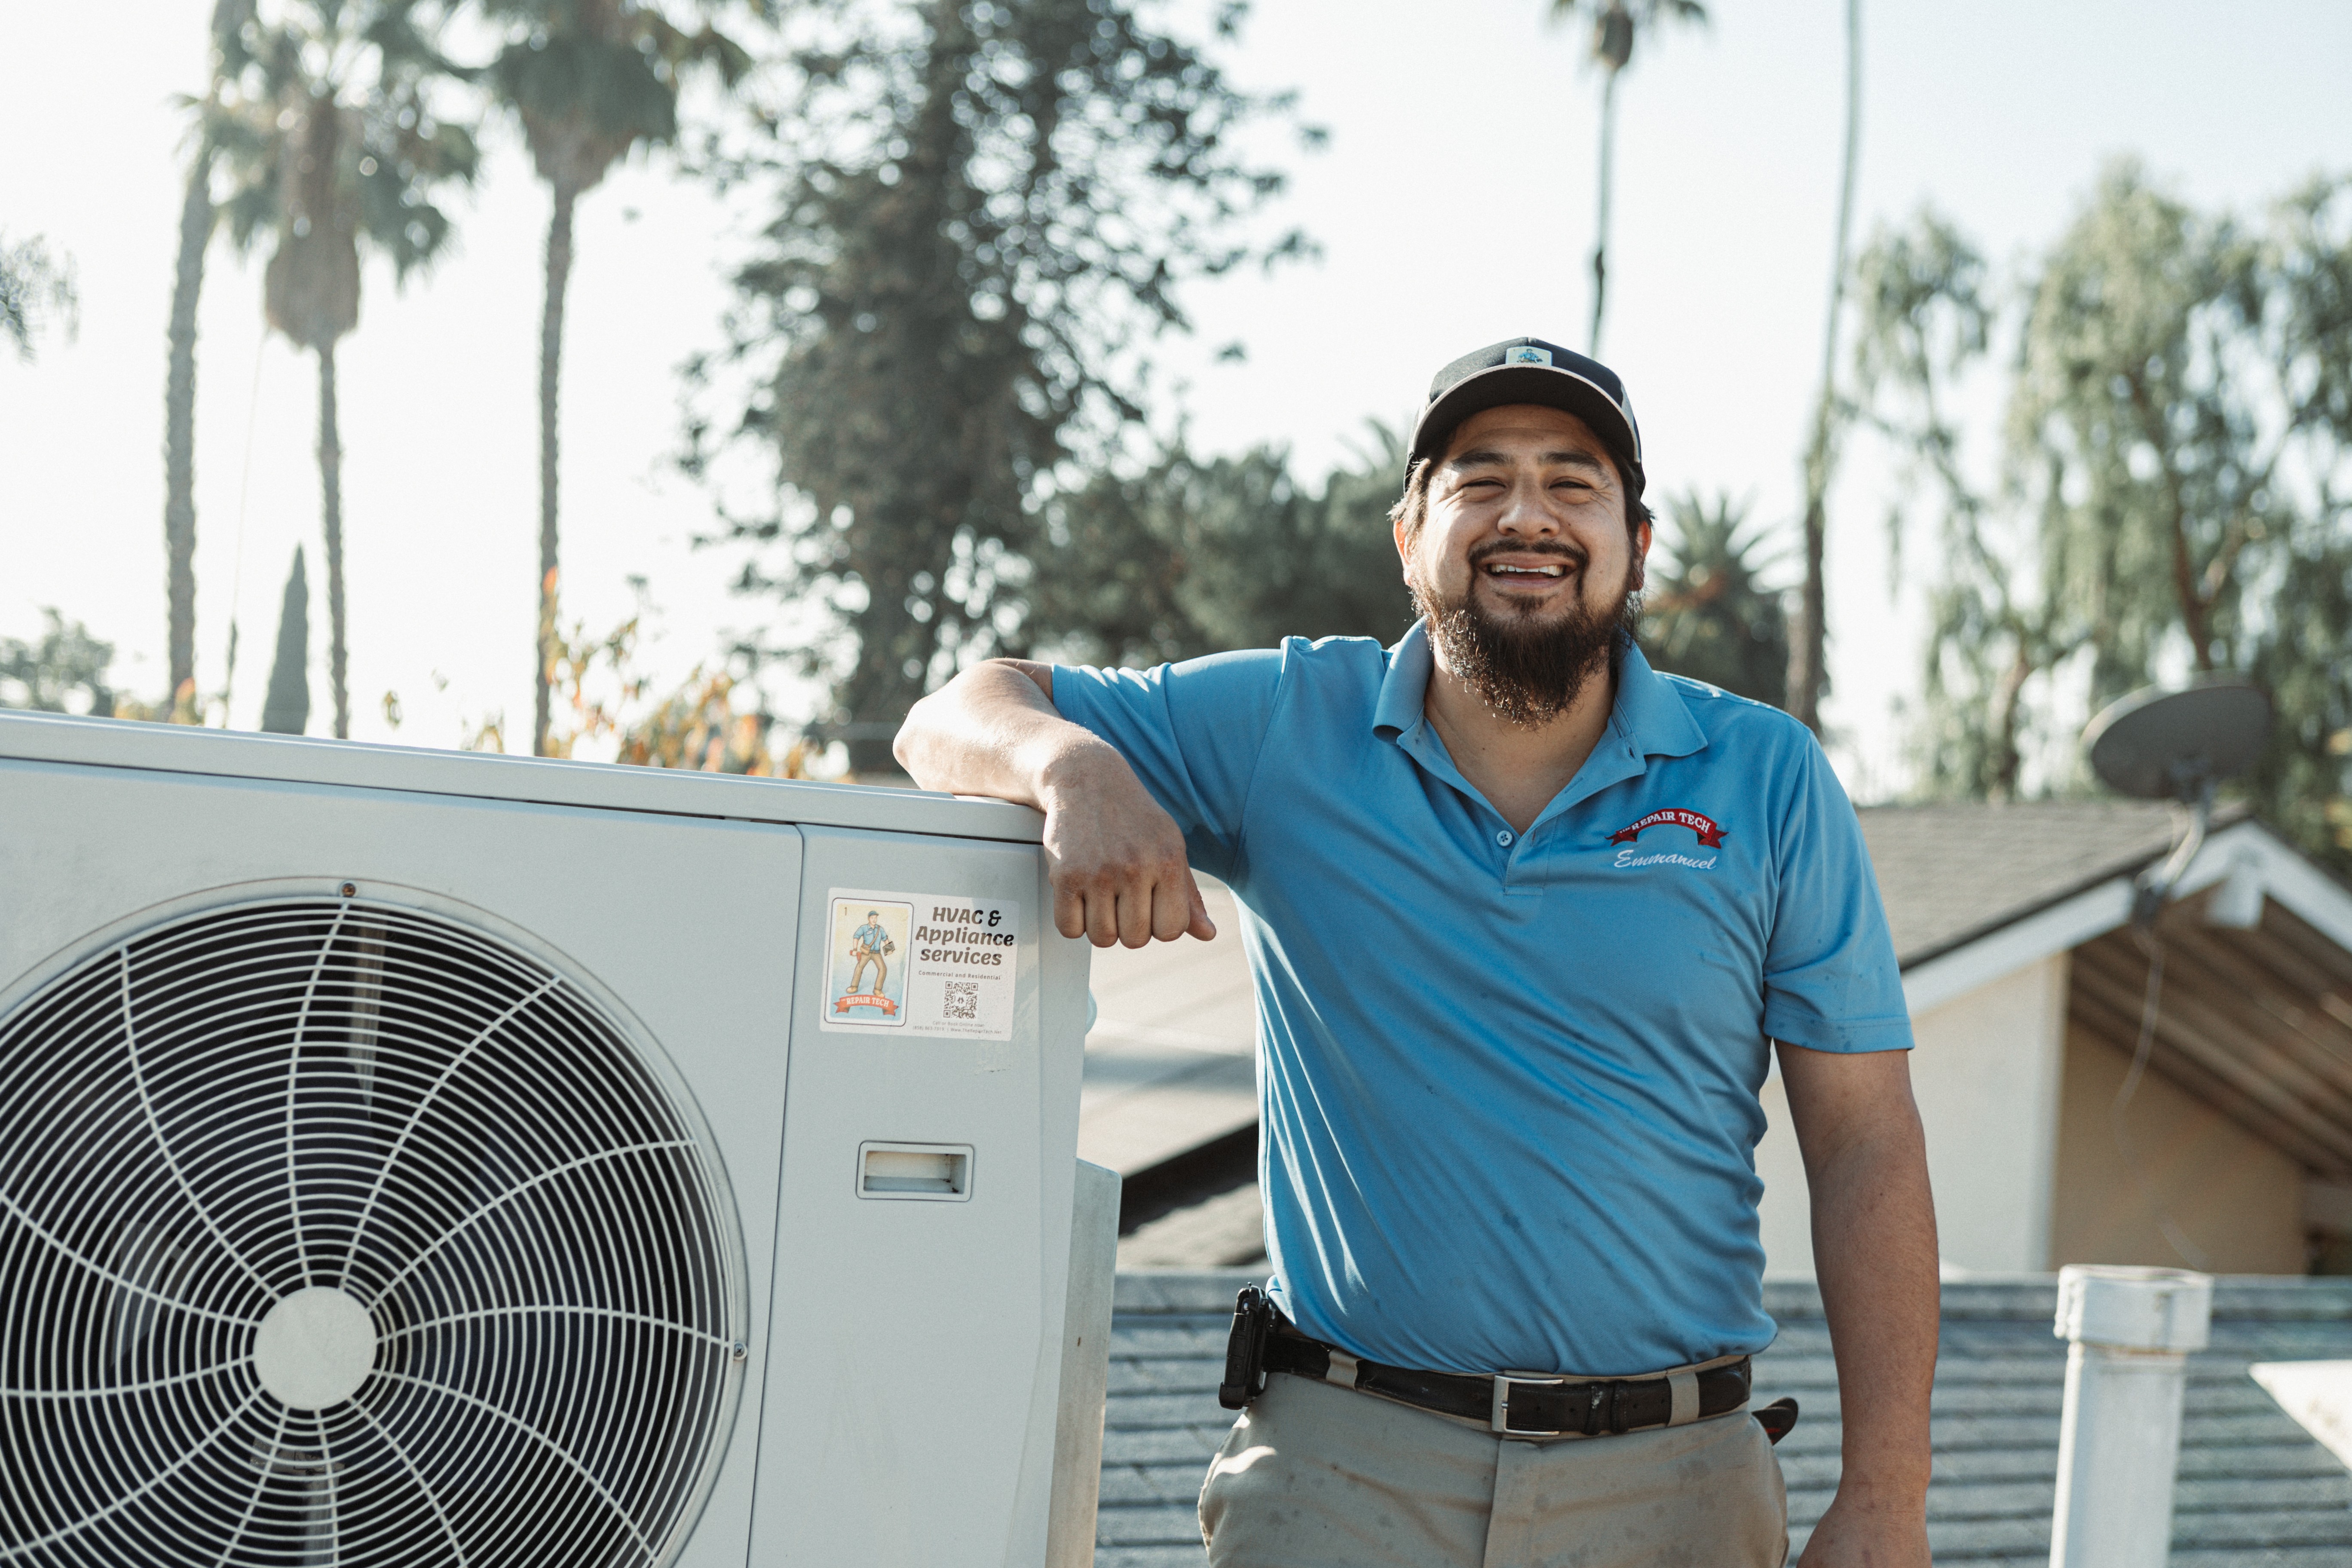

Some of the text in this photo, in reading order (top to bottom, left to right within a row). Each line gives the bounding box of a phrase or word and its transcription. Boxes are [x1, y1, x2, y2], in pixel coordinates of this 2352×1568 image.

[1632, 812, 1675, 830] REPAIR
[1679, 812, 1711, 833] TECH
[1614, 849, 1717, 870] Emmanuel
[844, 907, 847, 916] 1
[932, 906, 1001, 927] HVAC &
[915, 926, 1014, 947] Appliance
[920, 946, 1002, 966] services
[846, 996, 890, 1008] REPAIR TECH
